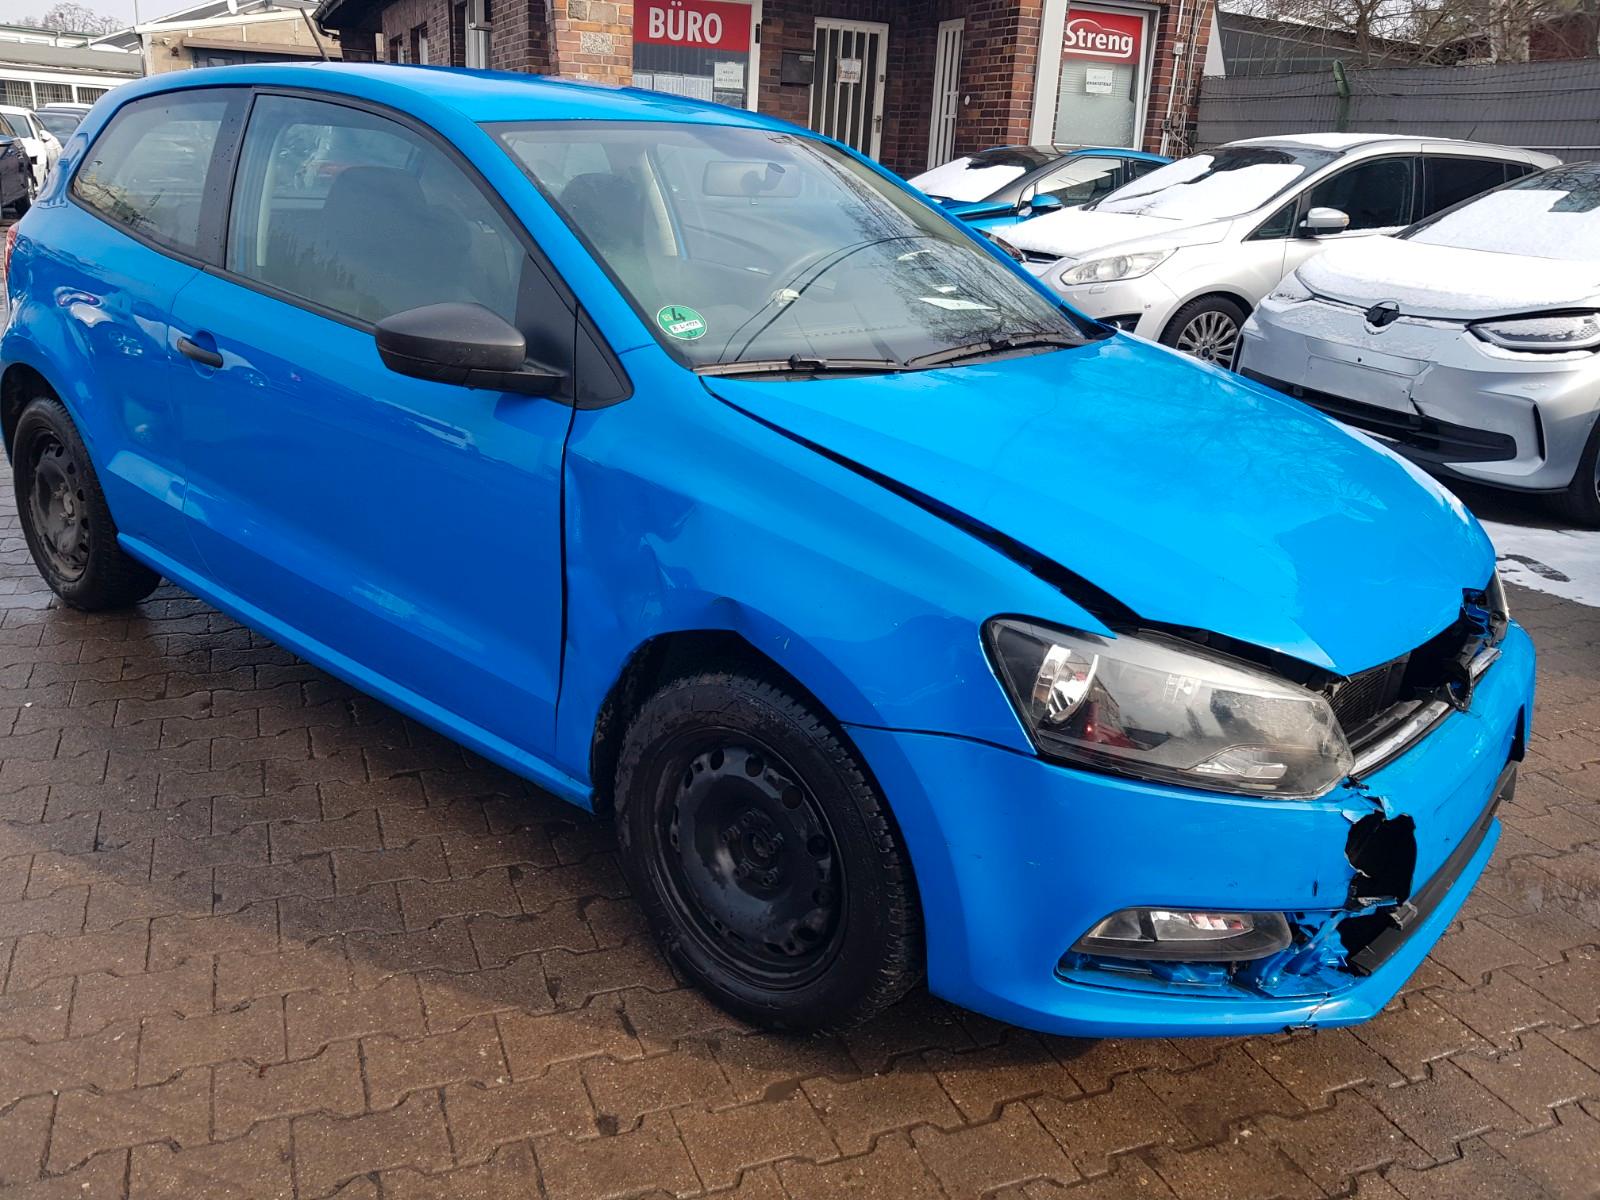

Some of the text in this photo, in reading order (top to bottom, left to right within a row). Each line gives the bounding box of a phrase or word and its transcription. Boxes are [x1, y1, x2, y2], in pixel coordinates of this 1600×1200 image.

[649, 1, 722, 44] BÜRO
[1064, 20, 1134, 58] Streng
[671, 307, 686, 321] 4
